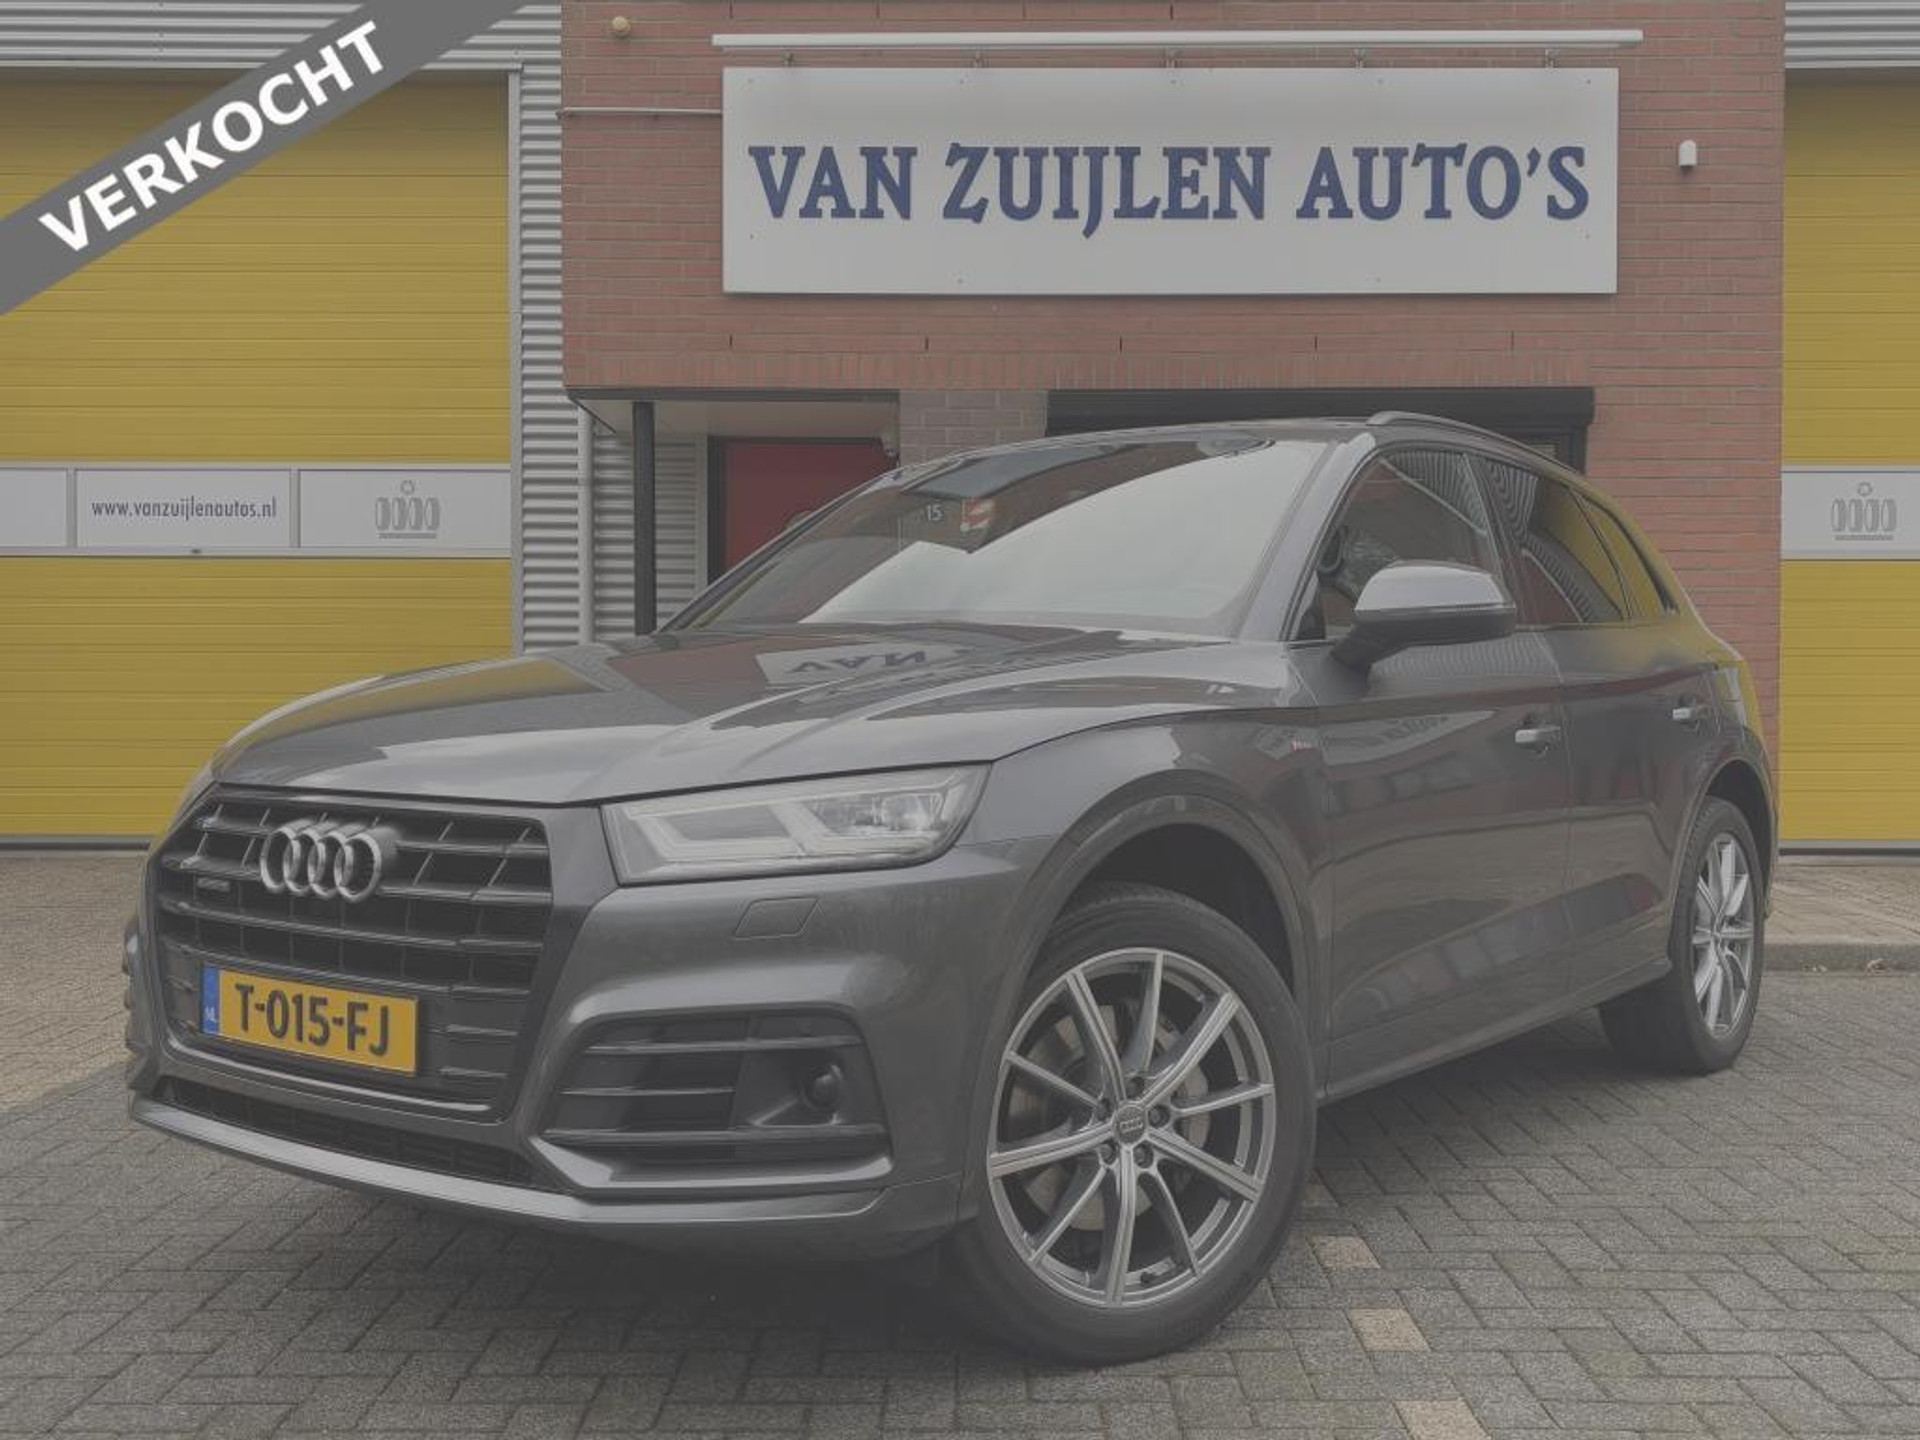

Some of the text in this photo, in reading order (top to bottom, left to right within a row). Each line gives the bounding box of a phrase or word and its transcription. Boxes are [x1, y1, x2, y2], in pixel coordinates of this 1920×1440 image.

[747, 142, 1590, 239] VAN ZUIJLEN AUTO'S
[91, 495, 277, 522] www.vanzuijlenautos.nl
[235, 983, 390, 1057] T-015-FJ
